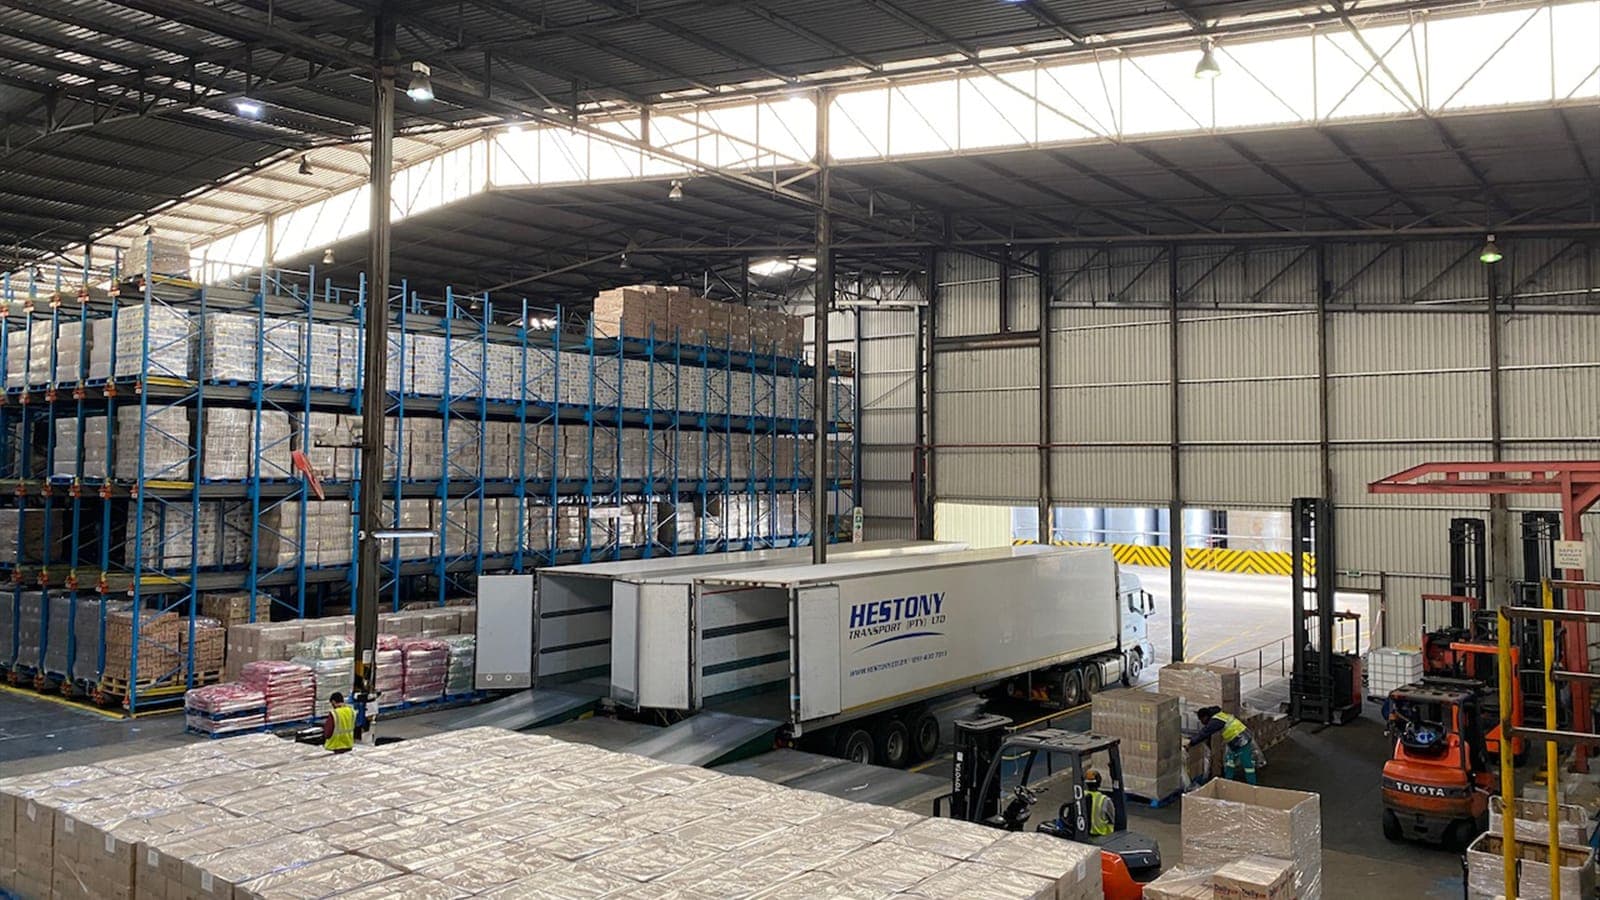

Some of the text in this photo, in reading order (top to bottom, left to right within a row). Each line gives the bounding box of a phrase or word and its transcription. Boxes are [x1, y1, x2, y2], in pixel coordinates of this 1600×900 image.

[849, 592, 946, 629] HESTONY
[849, 622, 902, 640] TRANSPORT
[931, 615, 946, 625] LTD
[1396, 782, 1445, 797] TOYOTA
